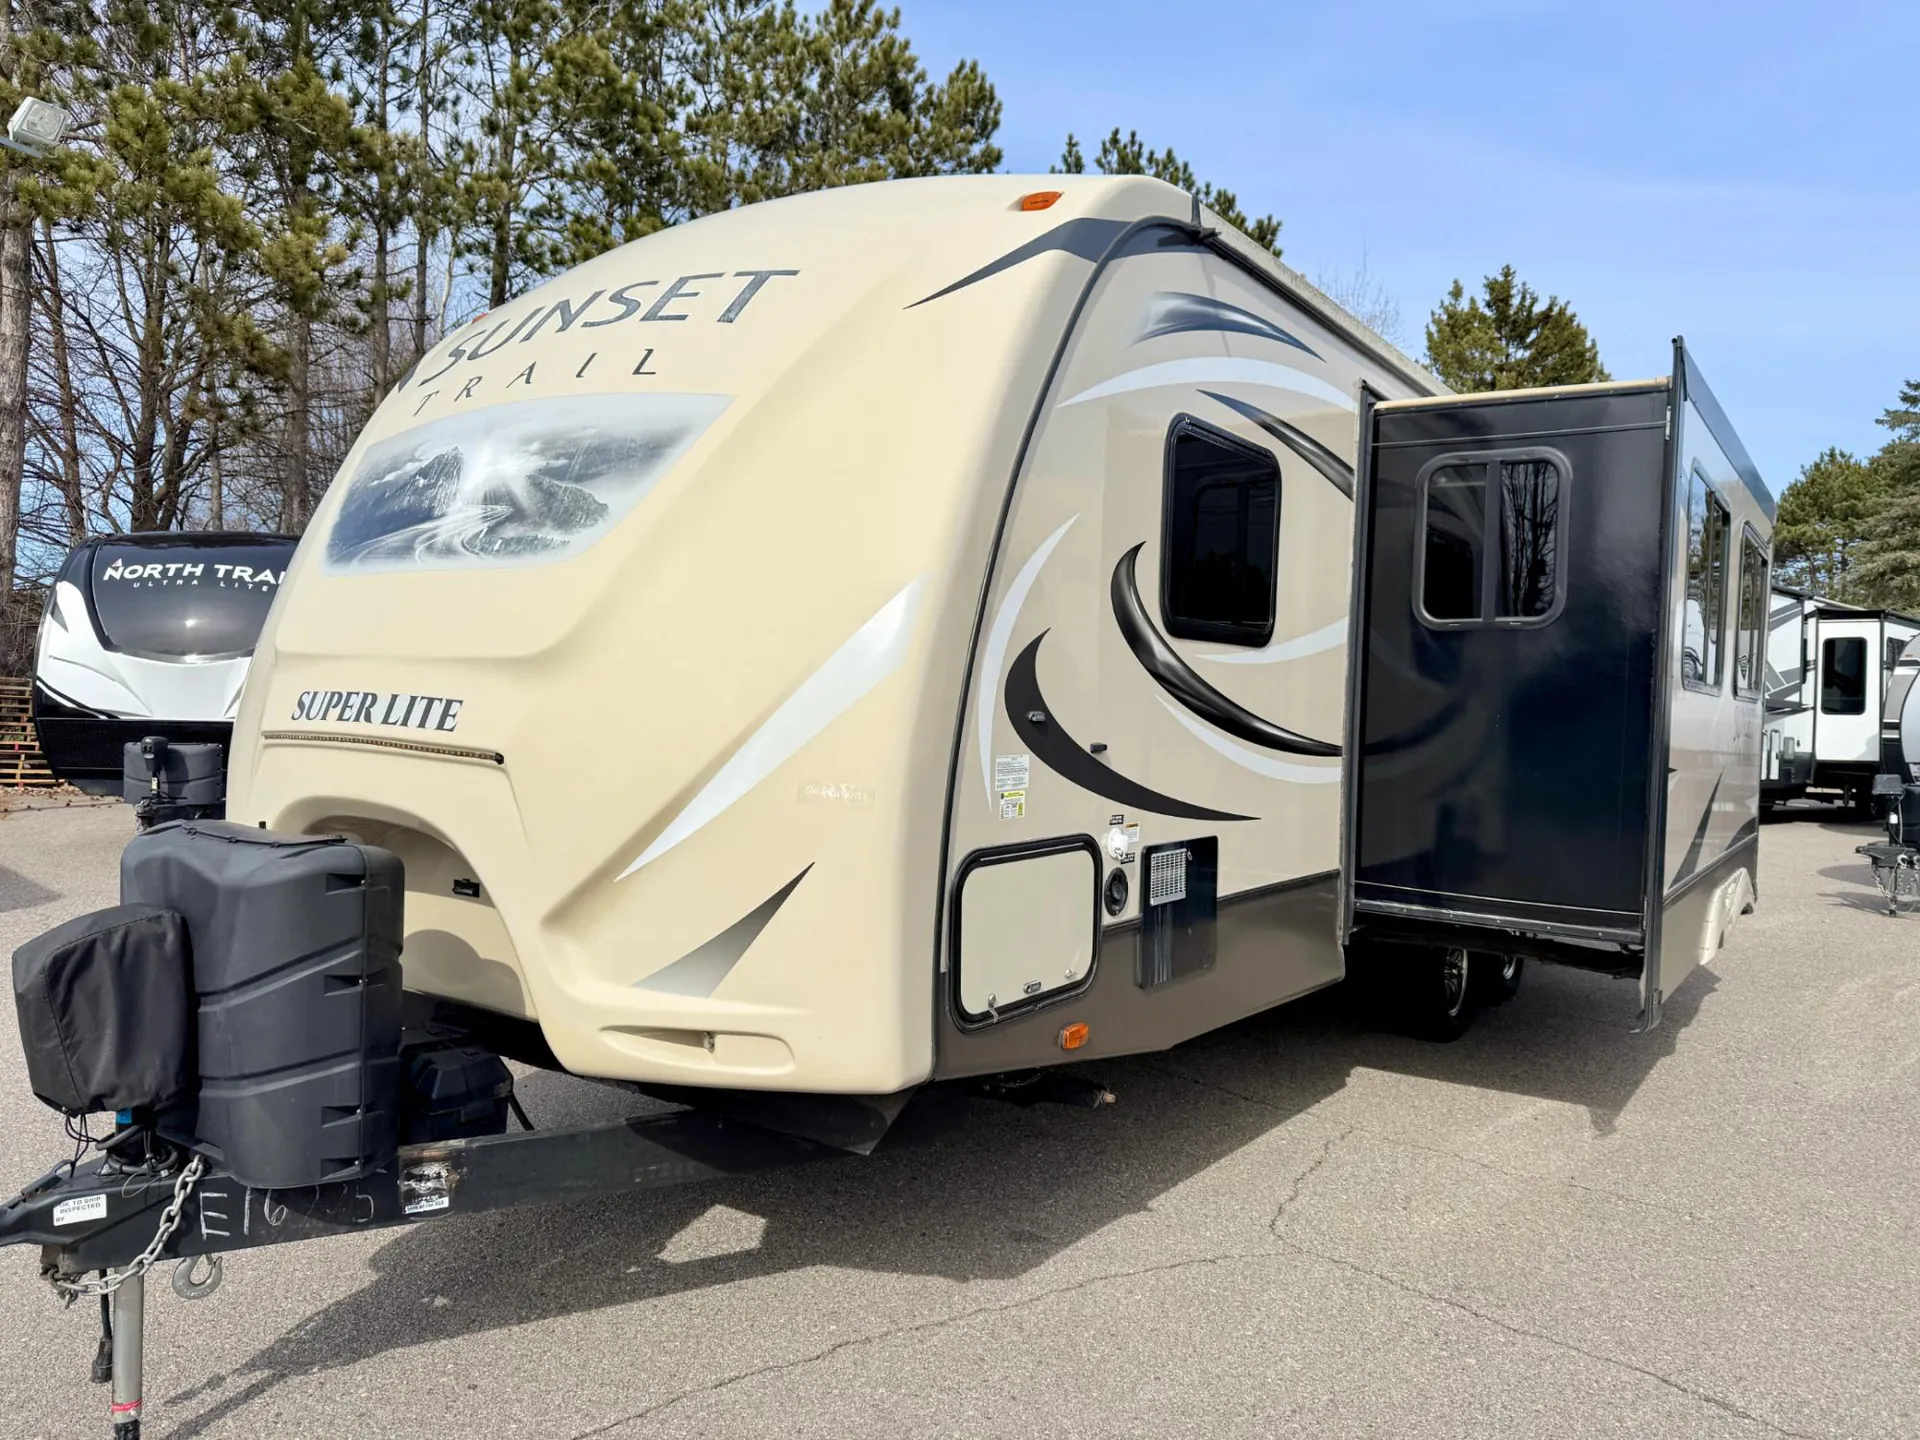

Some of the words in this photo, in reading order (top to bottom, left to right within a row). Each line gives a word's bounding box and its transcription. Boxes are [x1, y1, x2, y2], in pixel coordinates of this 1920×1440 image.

[420, 269, 801, 387] SUNSET
[413, 348, 657, 417] TRAIL
[103, 558, 204, 581] NORTH
[133, 579, 199, 588] ULTRA
[219, 580, 269, 592] LITE
[291, 690, 378, 724] SUPER
[380, 693, 463, 732] LITE
[60, 1202, 101, 1214] INSPECTED
[84, 1196, 101, 1204] SHIP
